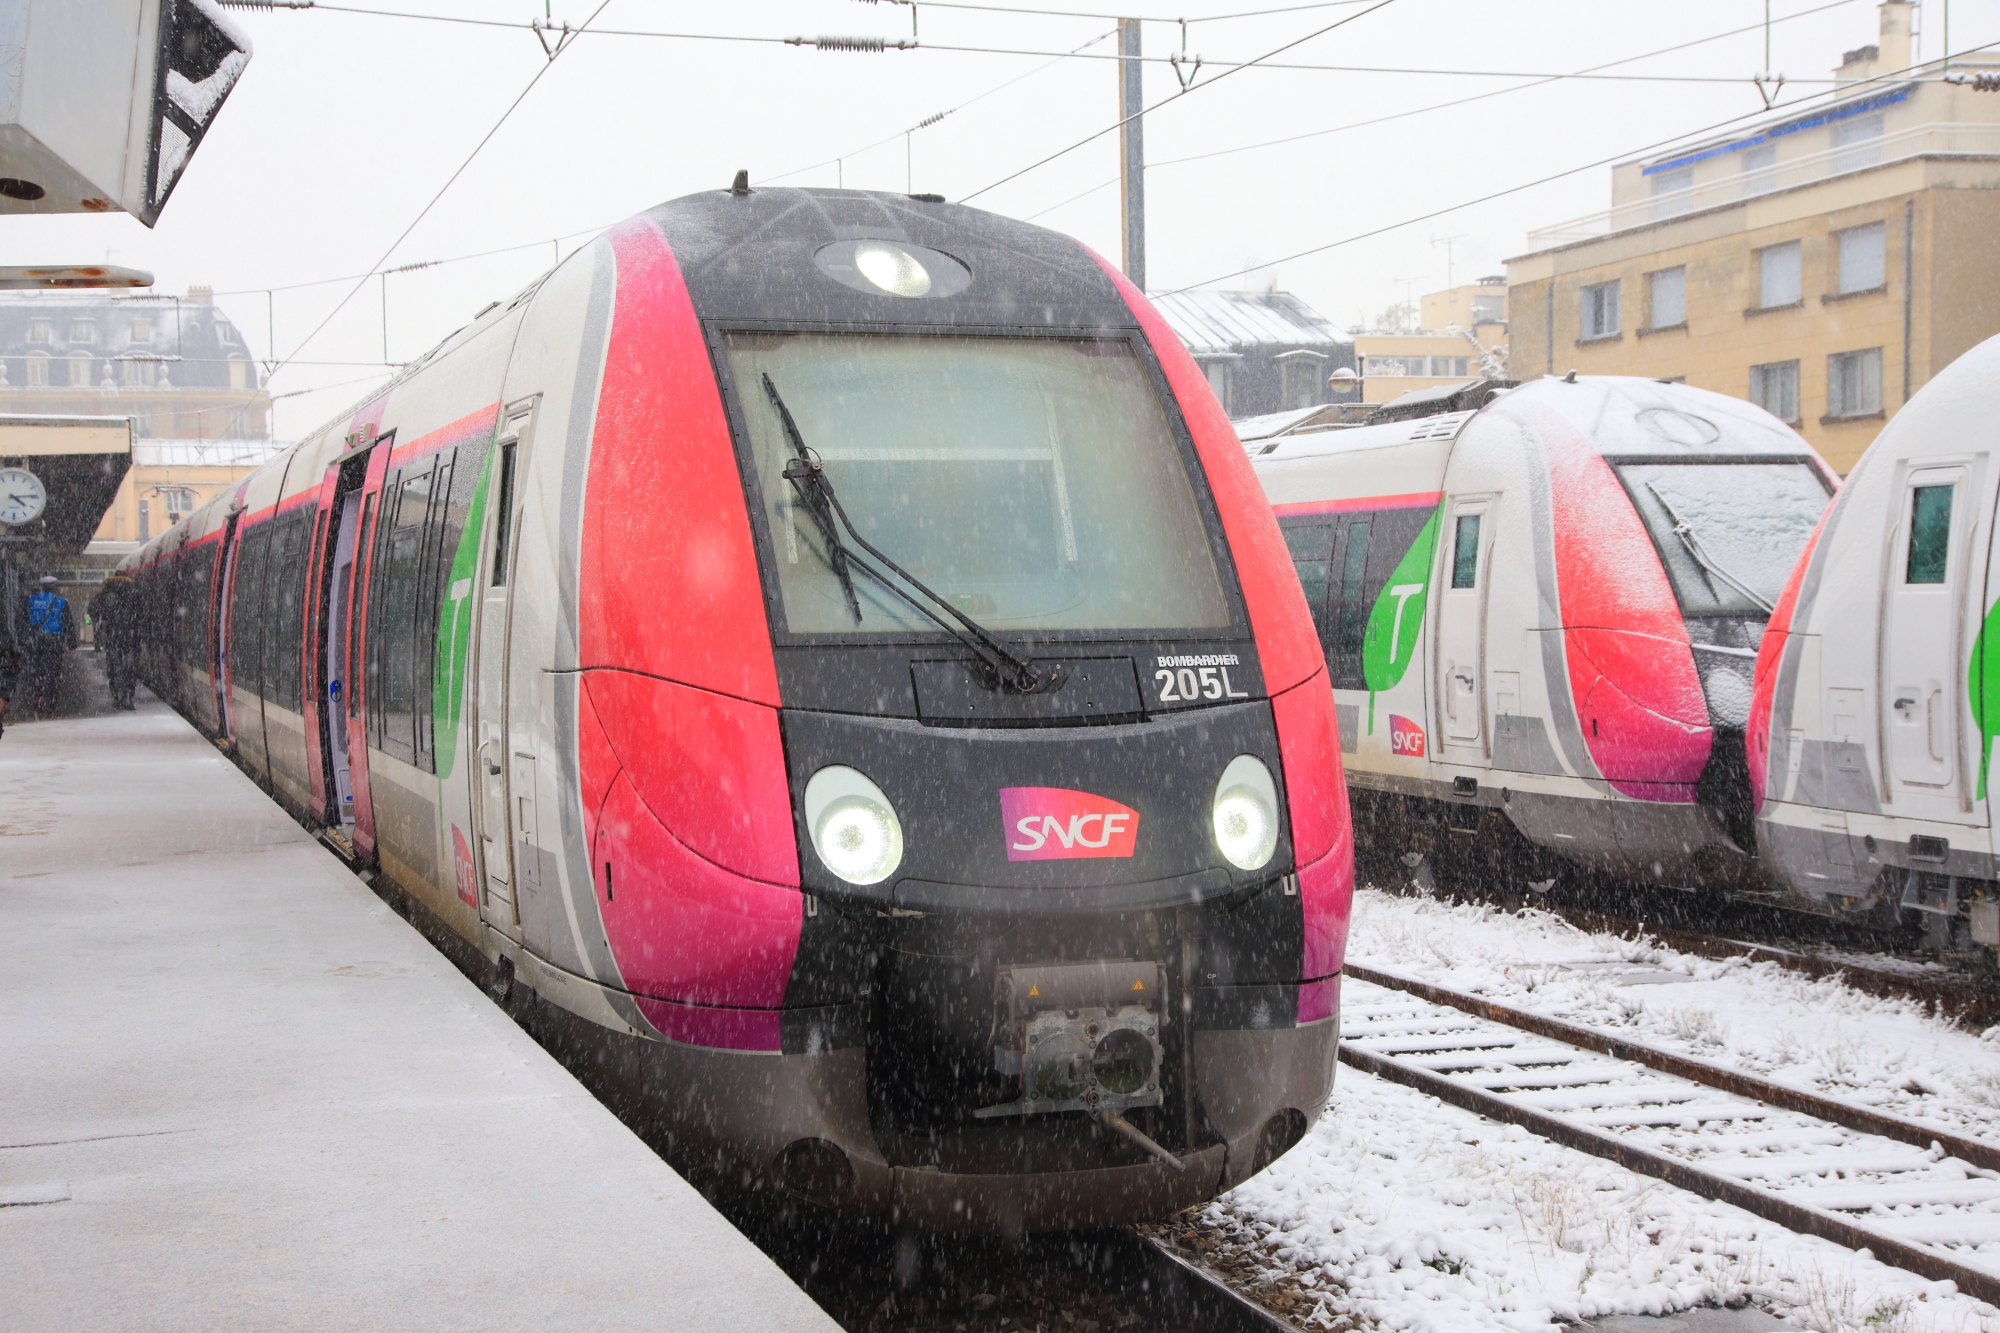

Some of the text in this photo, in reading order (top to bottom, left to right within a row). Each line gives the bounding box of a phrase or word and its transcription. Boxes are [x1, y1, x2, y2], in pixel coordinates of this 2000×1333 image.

[1157, 654, 1239, 668] BOMBARDIER
[1155, 666, 1249, 702] 205L
[1393, 730, 1423, 752] SNCF
[1012, 813, 1130, 851] SNCF
[455, 855, 474, 896] SNCF
